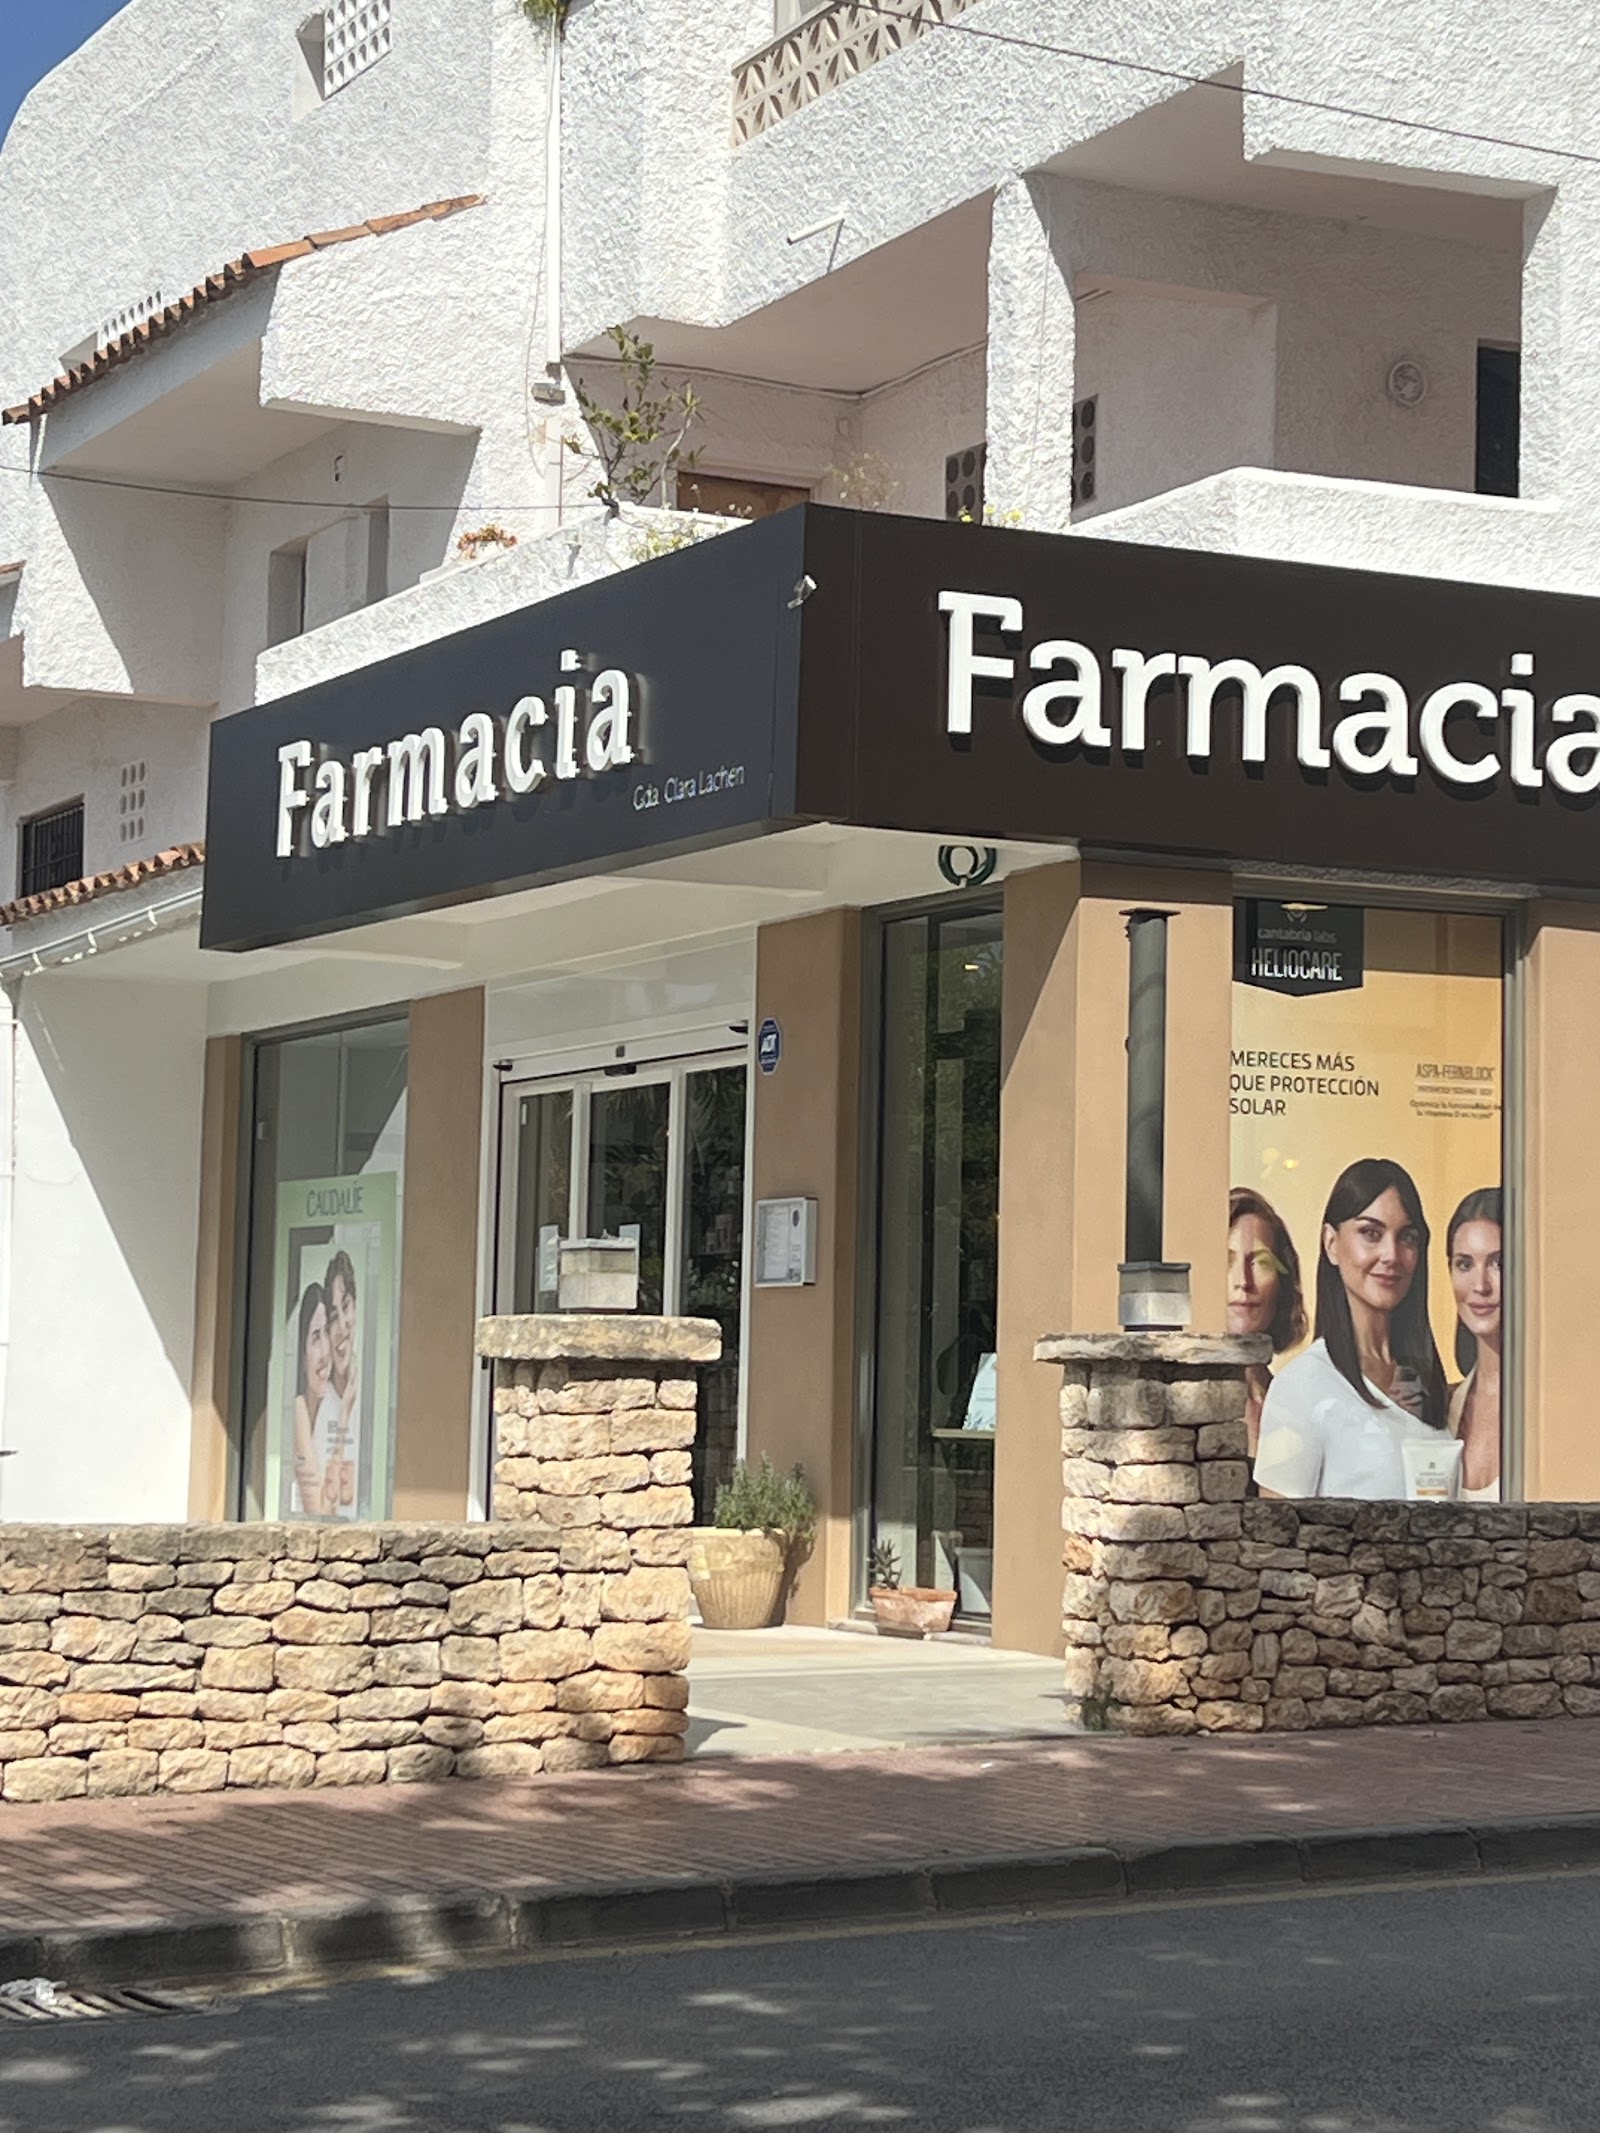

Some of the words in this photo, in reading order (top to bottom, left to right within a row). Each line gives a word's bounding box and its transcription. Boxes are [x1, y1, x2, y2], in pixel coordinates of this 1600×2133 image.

[938, 590, 1600, 794] Farmacia
[276, 649, 635, 857] Farmacia
[664, 777, 697, 803] Clara
[1251, 947, 1343, 981] HELIOCARE
[1230, 1050, 1312, 1070] MERECES
[1316, 1051, 1355, 1072] MÁS
[1229, 1074, 1265, 1093] QUE
[1270, 1075, 1379, 1097] PROTECCIÓN
[1229, 1098, 1286, 1116] SOLAR
